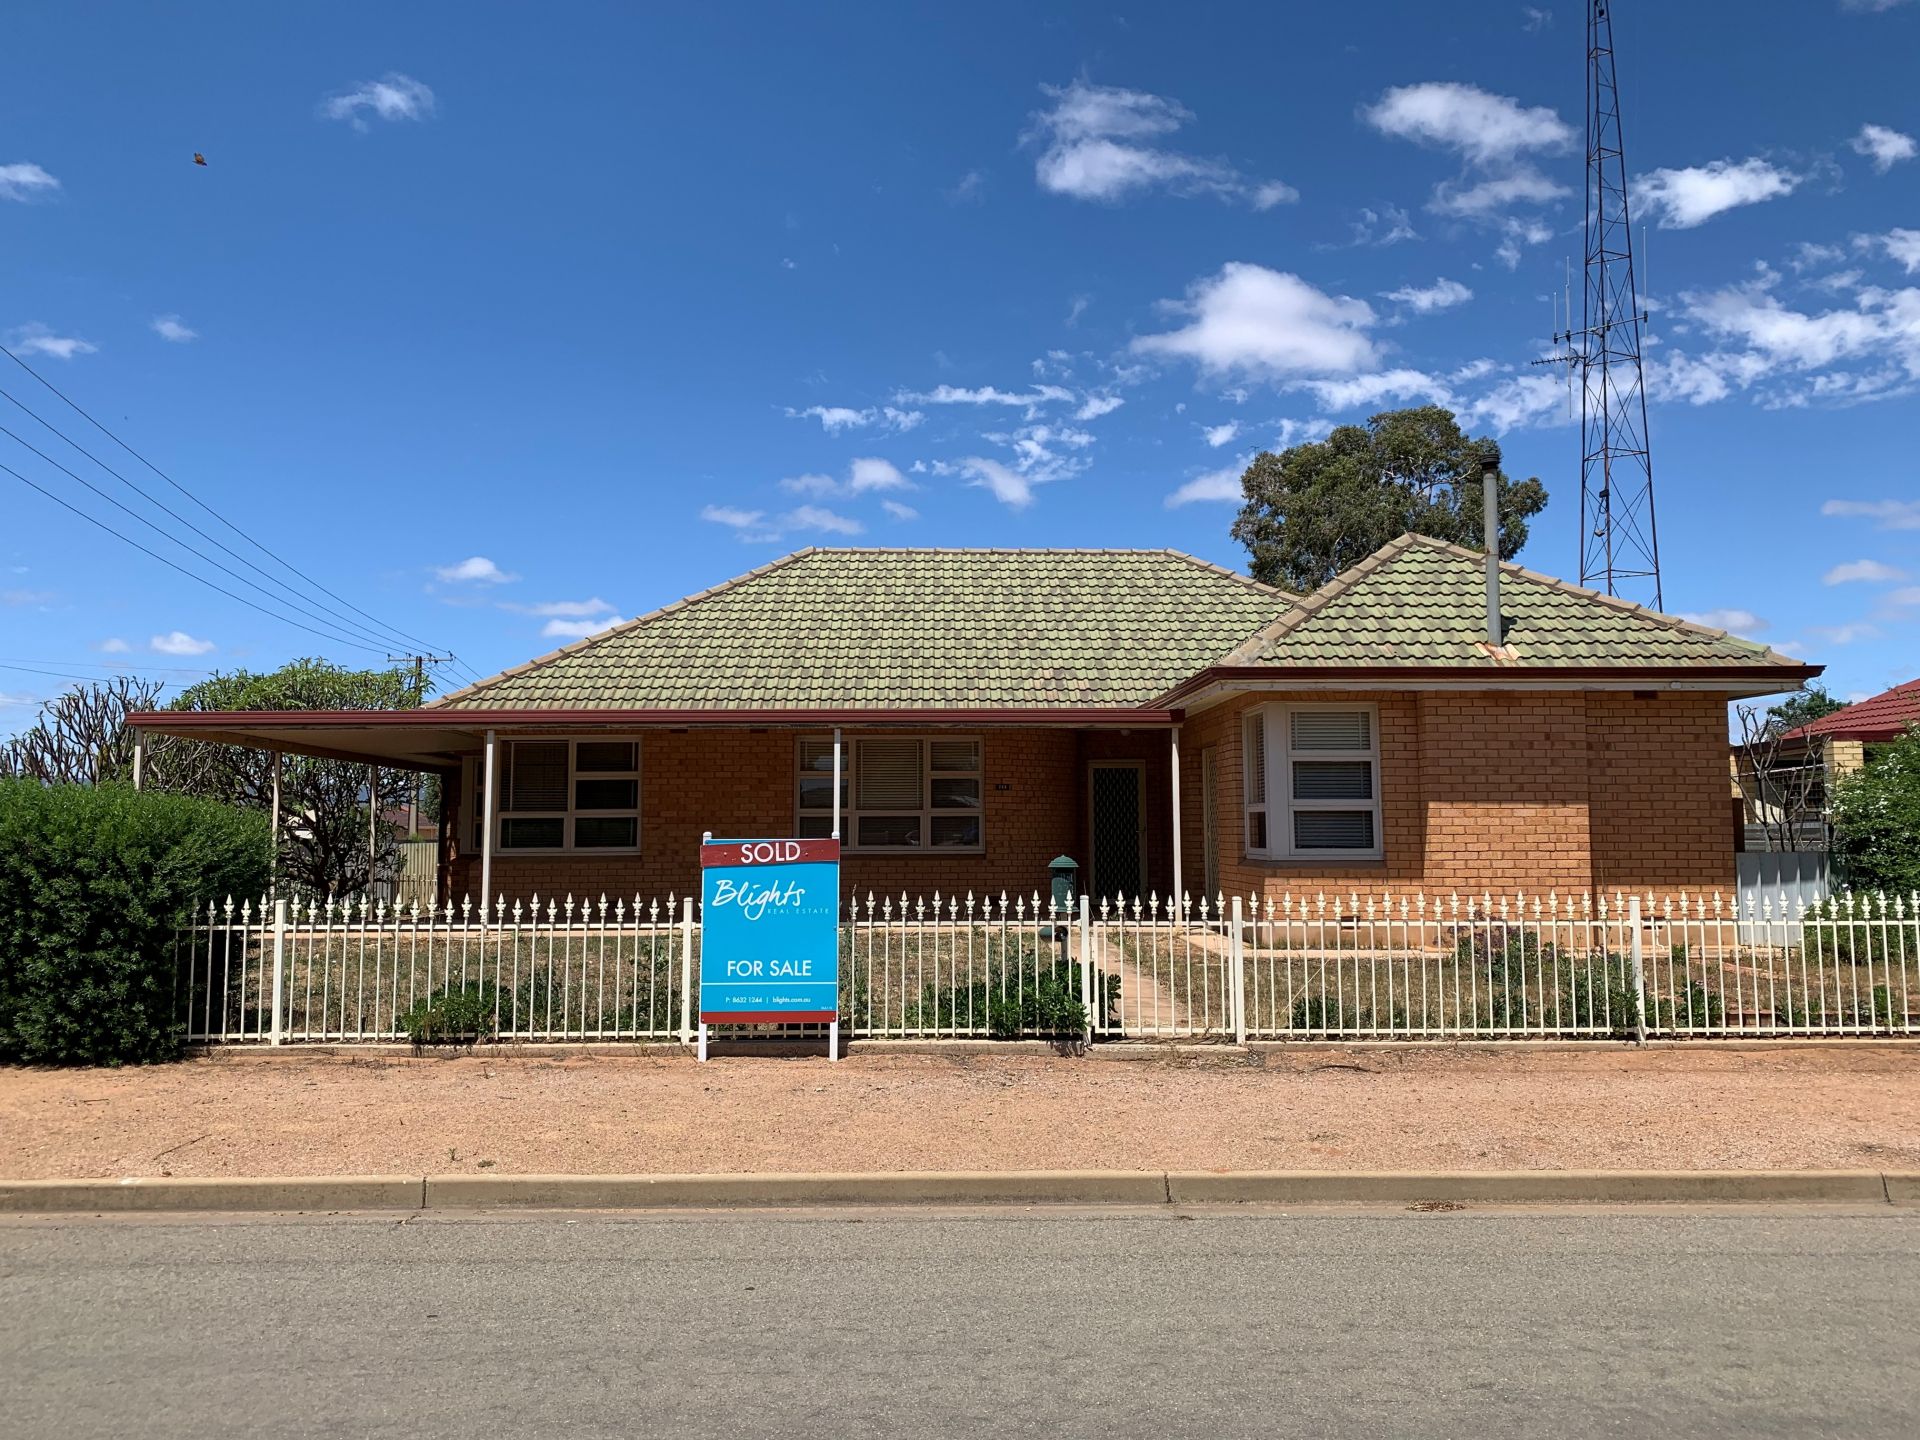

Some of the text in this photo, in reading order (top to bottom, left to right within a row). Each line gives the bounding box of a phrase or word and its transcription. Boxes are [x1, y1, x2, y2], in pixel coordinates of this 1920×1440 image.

[741, 842, 801, 863] SOLD
[712, 880, 805, 920] Blights
[727, 960, 812, 976] FOR SALE
[772, 995, 811, 1004] blights.com.au
